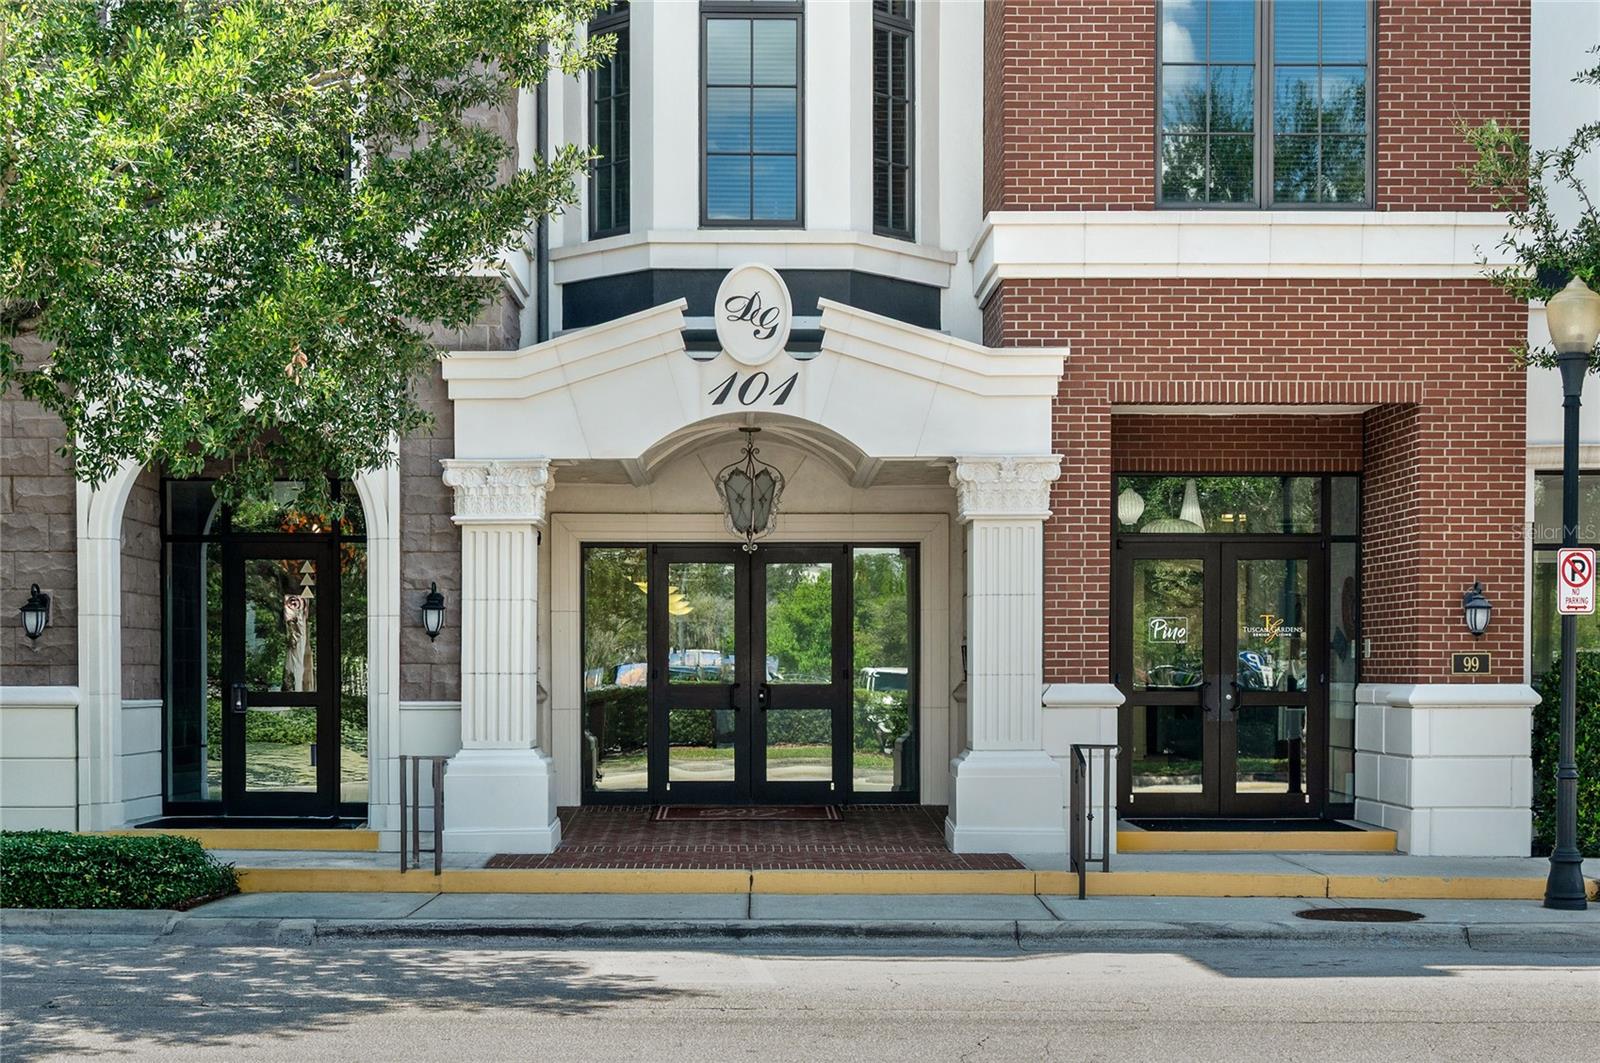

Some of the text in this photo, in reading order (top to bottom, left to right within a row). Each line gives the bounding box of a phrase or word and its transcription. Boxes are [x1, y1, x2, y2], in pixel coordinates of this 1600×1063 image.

[708, 371, 799, 406] 101
[1572, 588, 1580, 596] NO
[1565, 596, 1589, 604] PARKING
[1463, 656, 1480, 672] 99
